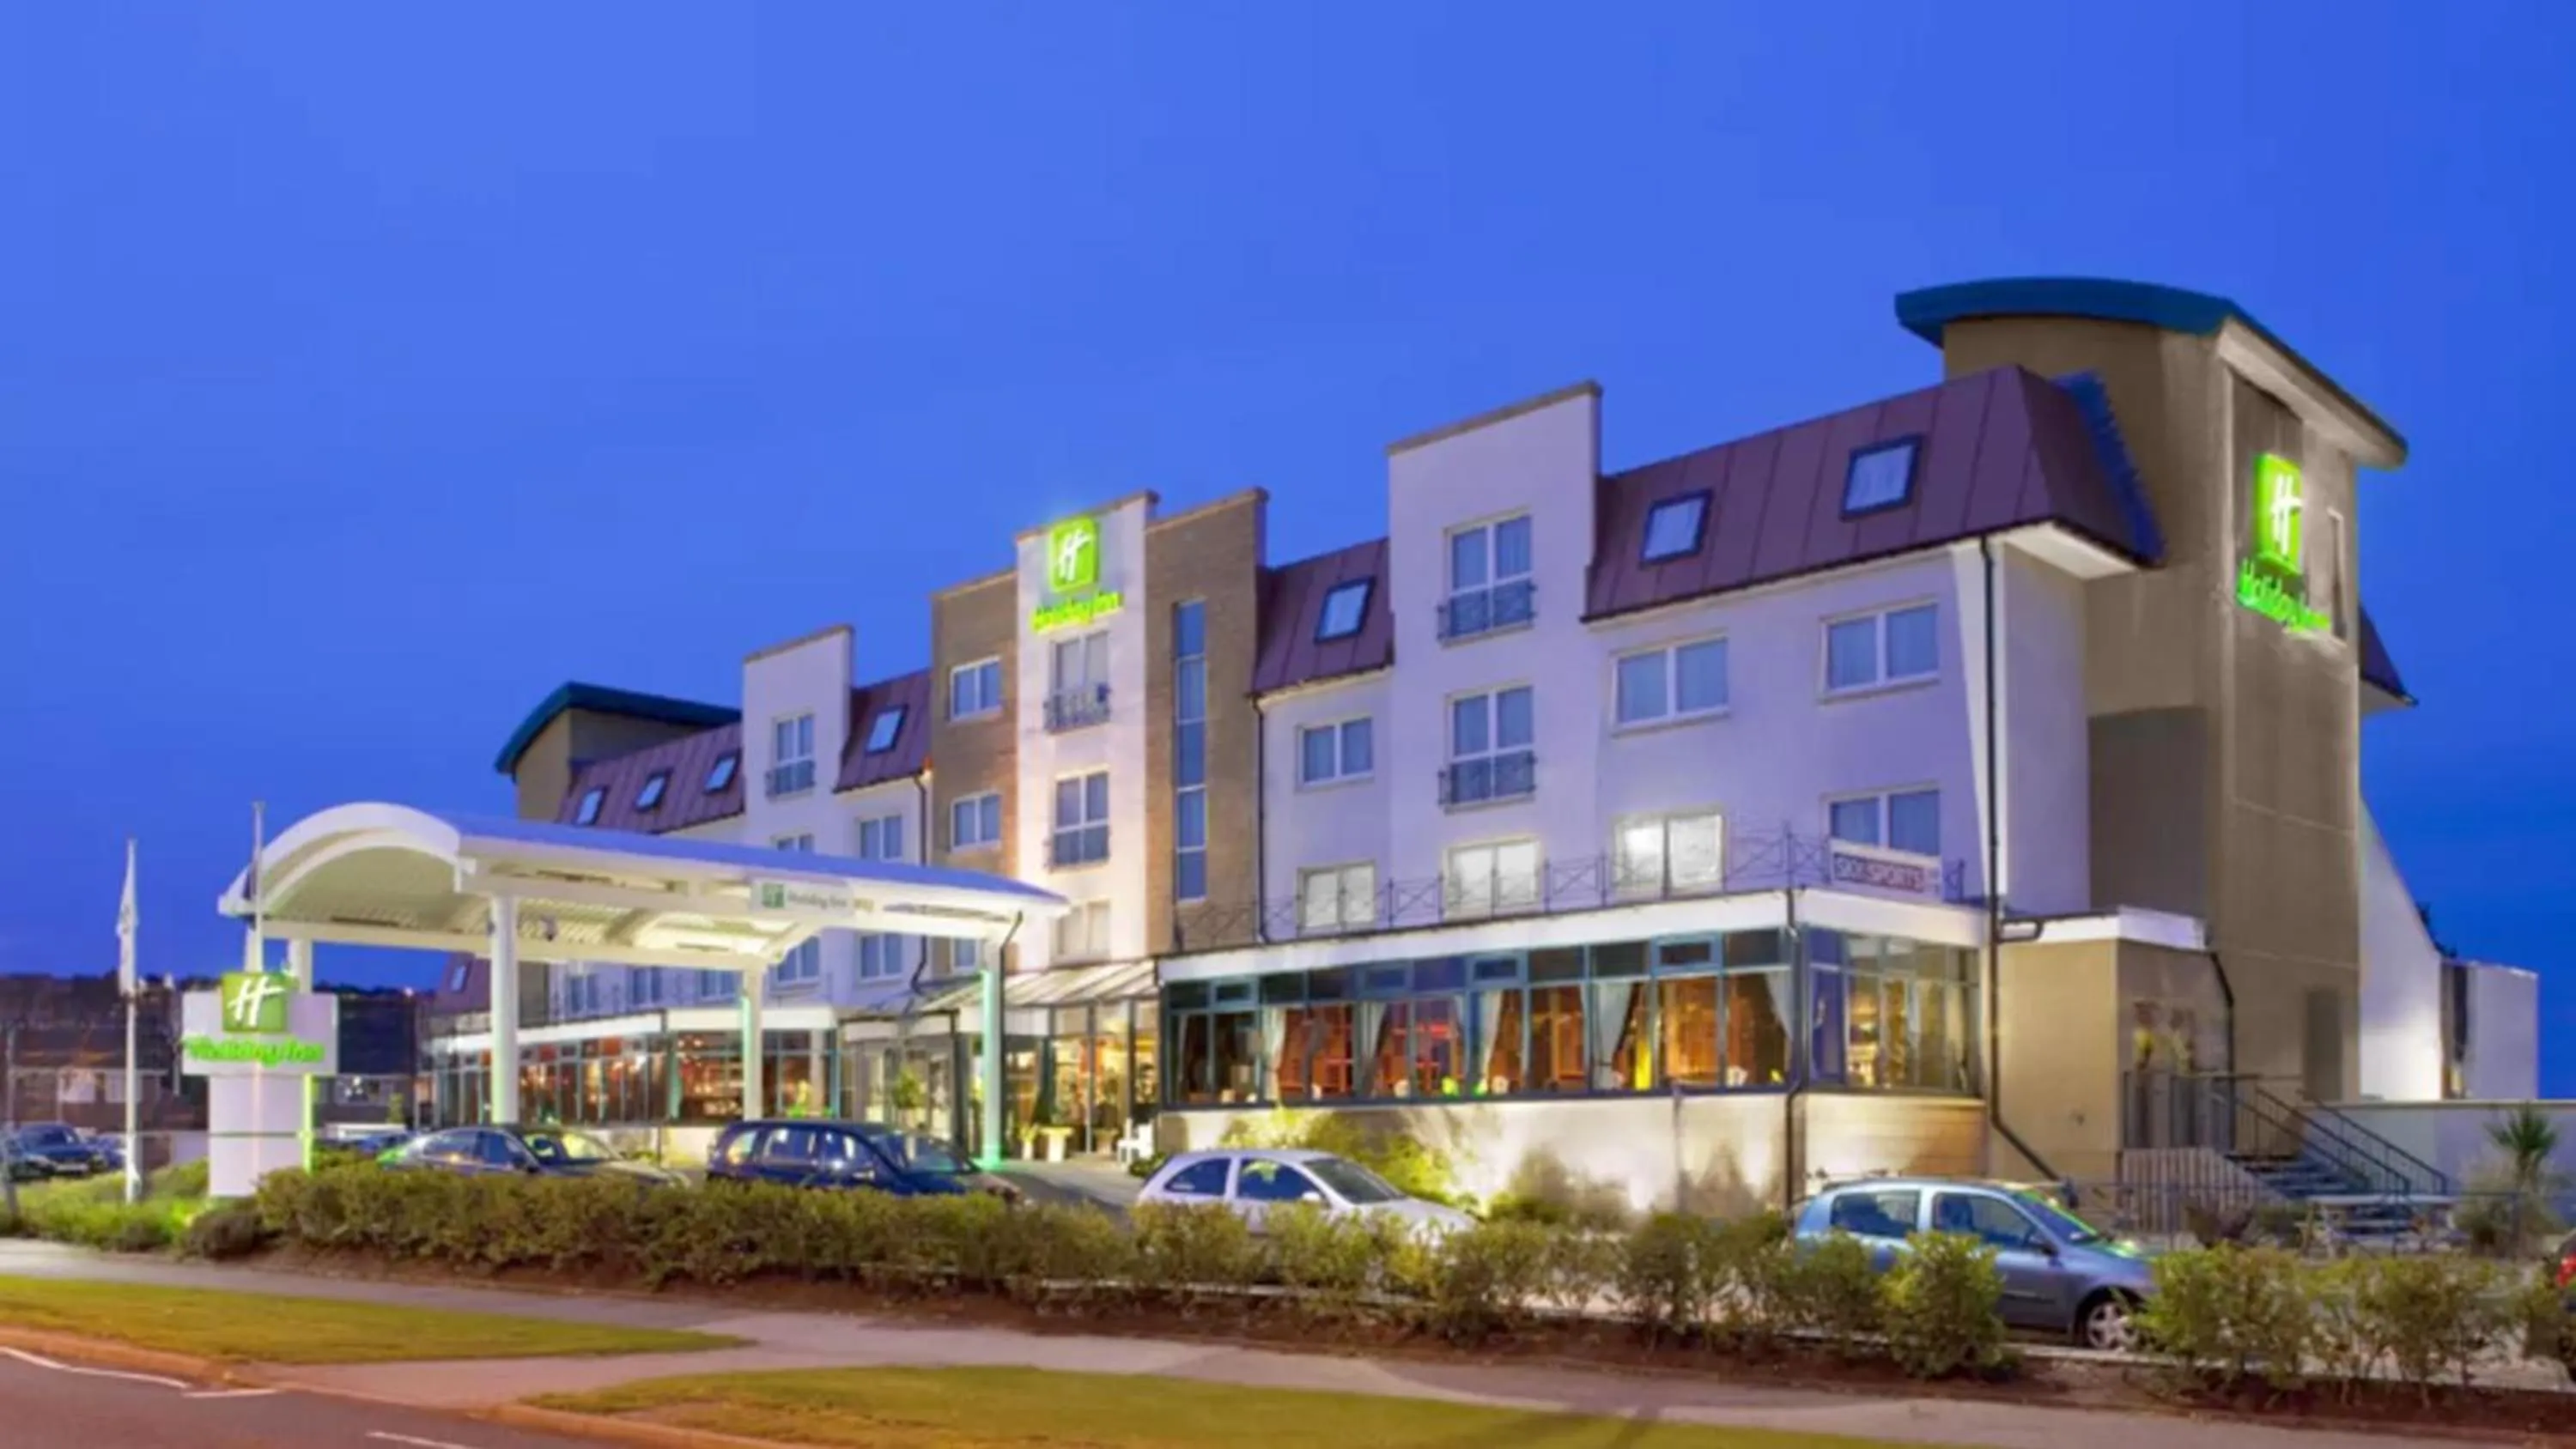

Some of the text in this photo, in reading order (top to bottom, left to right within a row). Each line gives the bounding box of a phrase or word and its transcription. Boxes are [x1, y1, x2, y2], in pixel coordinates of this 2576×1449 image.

[2236, 557, 2303, 632] Holiday
[1031, 596, 1093, 634] Holiday
[182, 1035, 282, 1068] Holiday
